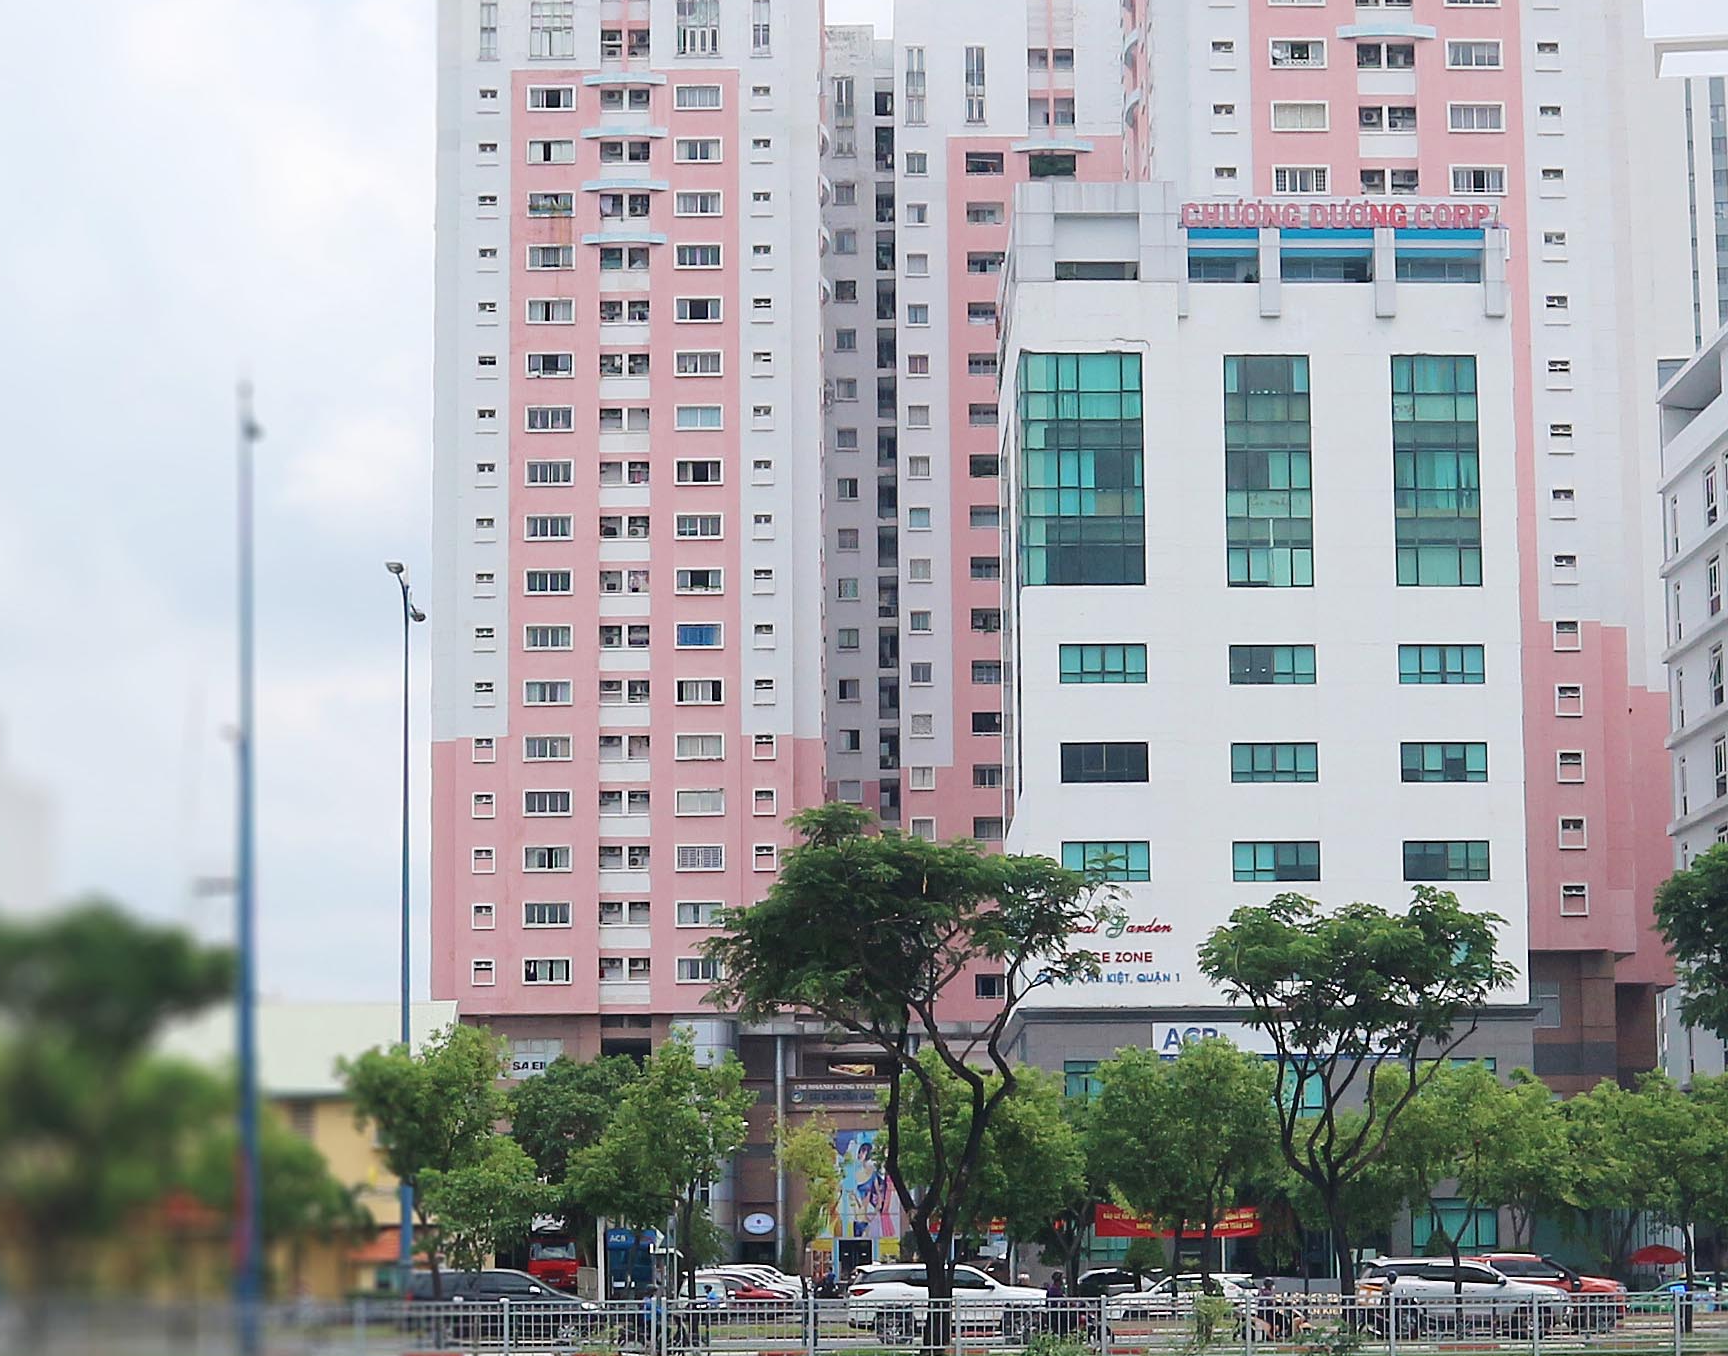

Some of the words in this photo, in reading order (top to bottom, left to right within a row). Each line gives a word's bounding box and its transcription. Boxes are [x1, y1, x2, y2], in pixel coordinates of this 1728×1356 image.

[1414, 203, 1490, 229] CORP
[1115, 952, 1153, 963] ZONE
[1136, 972, 1171, 985] QUẬN
[1176, 973, 1181, 982] 1
[609, 1234, 626, 1242] ACB
